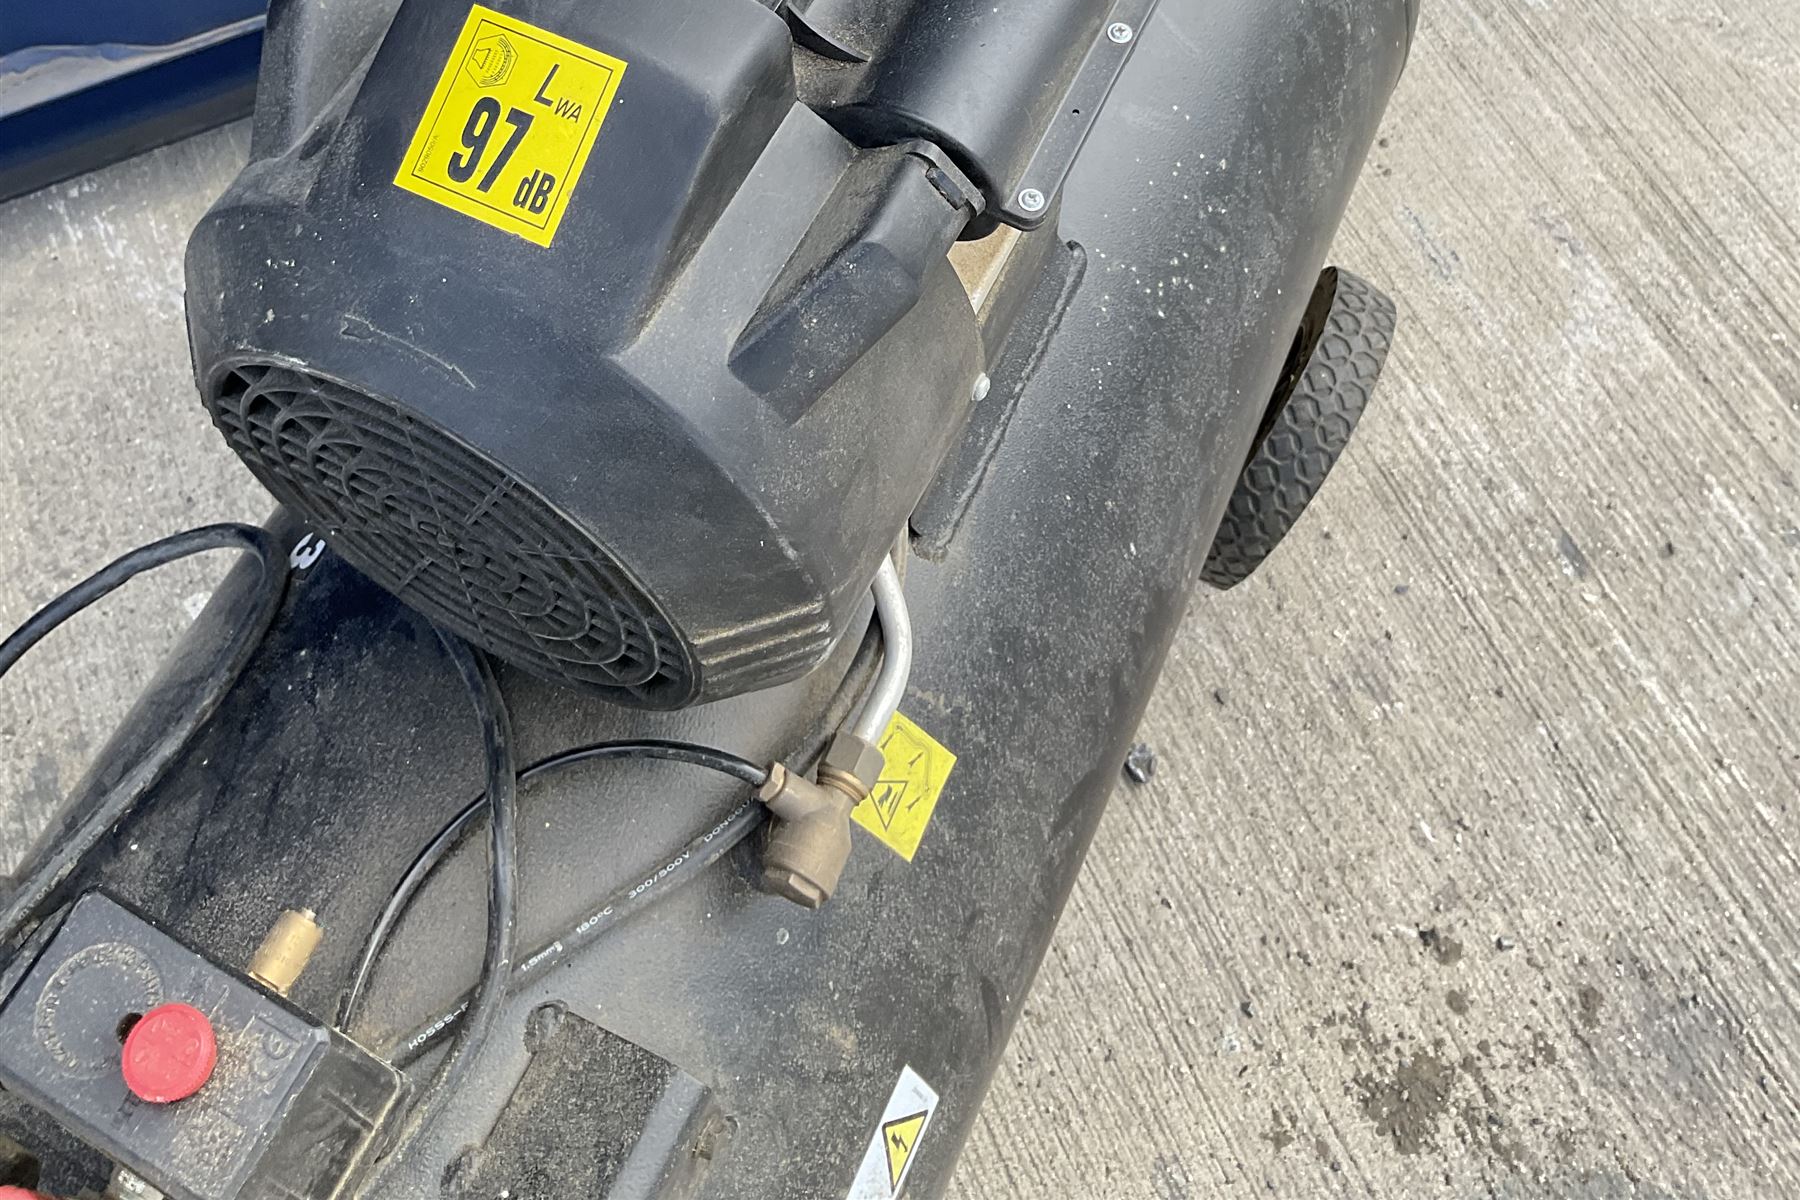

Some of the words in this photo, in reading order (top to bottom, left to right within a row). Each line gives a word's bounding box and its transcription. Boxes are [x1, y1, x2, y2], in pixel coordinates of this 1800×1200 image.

[447, 96, 535, 194] 97
[513, 169, 556, 215] dB
[628, 850, 692, 899] 300/500V
